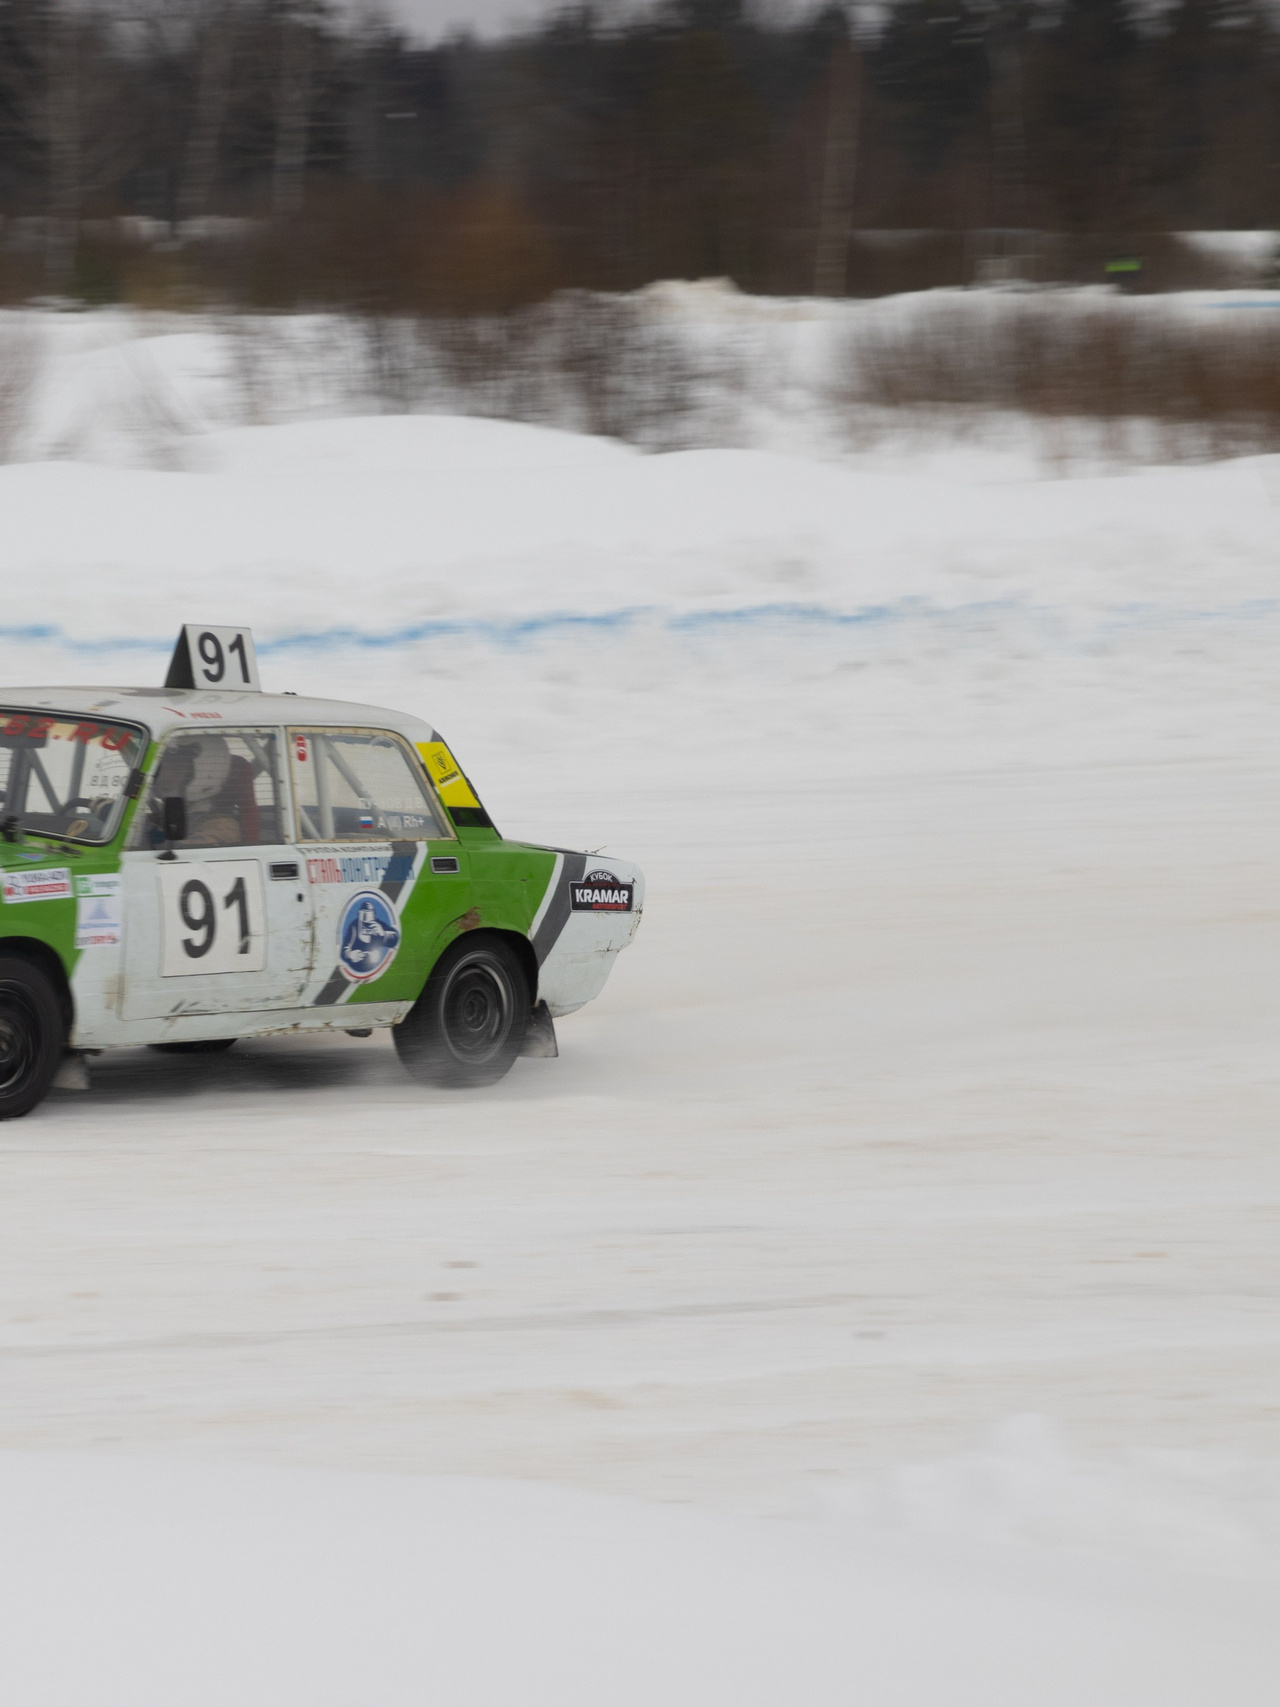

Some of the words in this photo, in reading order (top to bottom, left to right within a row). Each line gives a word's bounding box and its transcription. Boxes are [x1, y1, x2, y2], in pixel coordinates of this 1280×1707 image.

[198, 631, 251, 684] 91
[590, 872, 613, 882] КУБОК
[575, 889, 629, 904] KRAMAR
[180, 876, 251, 959] 91
